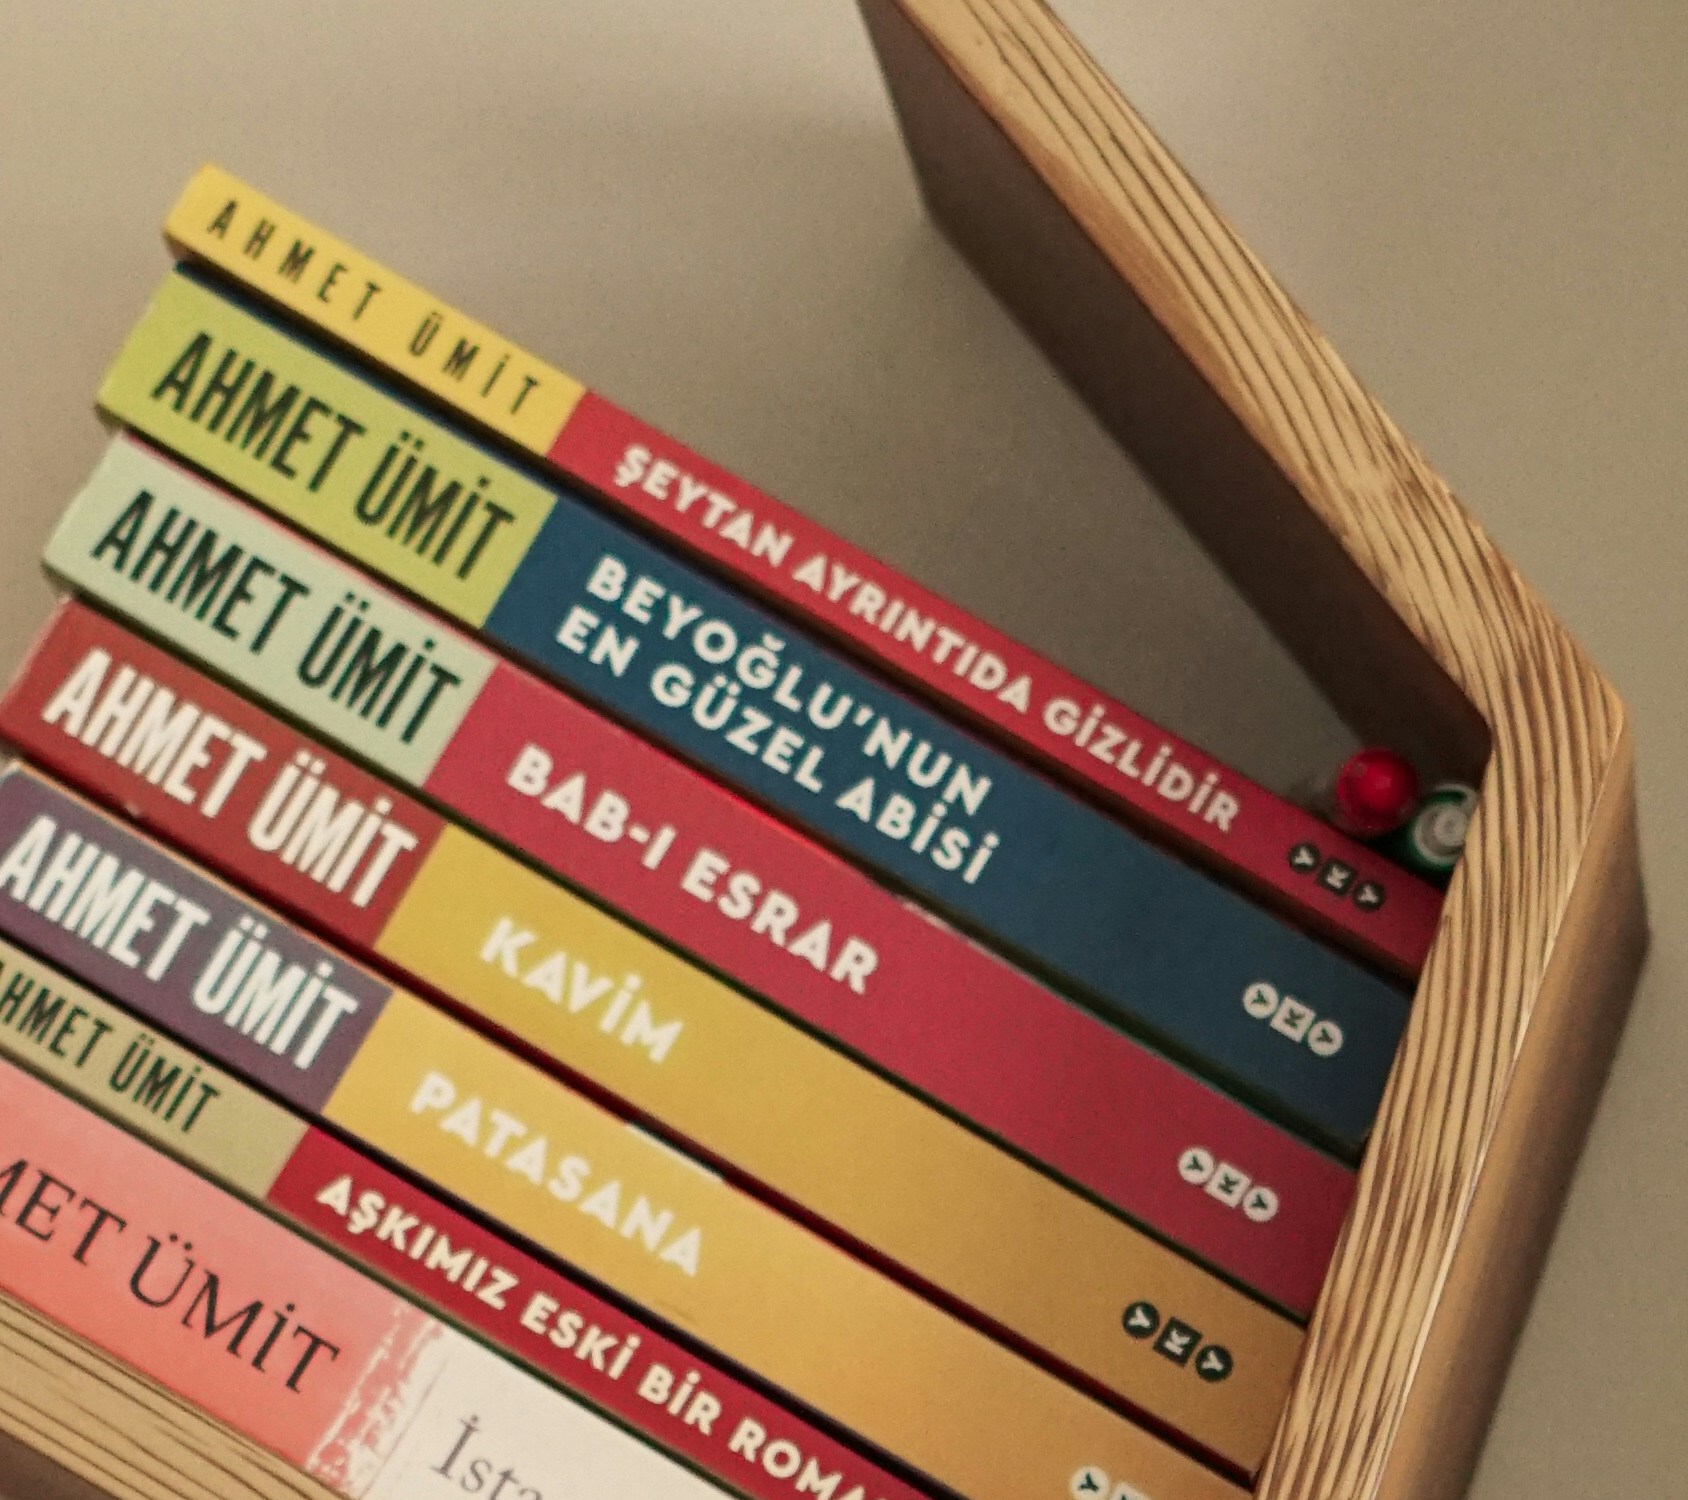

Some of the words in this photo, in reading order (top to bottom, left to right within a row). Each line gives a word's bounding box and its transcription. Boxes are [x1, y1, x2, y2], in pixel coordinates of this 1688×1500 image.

[207, 200, 382, 322] AHMET
[407, 311, 539, 415] ÜMİT
[153, 332, 367, 493] AHMET
[355, 432, 517, 579] ÜMİT
[91, 490, 311, 654] AHMET
[297, 591, 461, 747] ÜMİT
[557, 606, 639, 678] EN
[651, 664, 825, 793] GÜZEL
[836, 778, 1000, 884] ABİSİ
[587, 556, 991, 816] BEYOĞLU'NUN
[614, 444, 794, 567] ŞEYTAN
[793, 554, 1031, 713] AYRINTIDA
[1042, 696, 1240, 833] GİZLİDİR
[42, 649, 267, 817] AHMET
[247, 749, 417, 909] ÜMİT
[506, 743, 676, 870] BAB-I
[682, 848, 879, 995] ESRAR
[0, 814, 211, 983] AHMET
[193, 915, 359, 1071] ÜMİT
[0, 959, 113, 1068] HMET
[109, 1032, 221, 1133] ÜMİT
[480, 917, 684, 1065] KAVİM
[409, 1071, 702, 1277] PATASANA
[130, 1233, 340, 1393] ÜMİT
[316, 1175, 519, 1312] AŞKIMIZ
[520, 1291, 641, 1381] ESKİ
[637, 1362, 722, 1436] BİR
